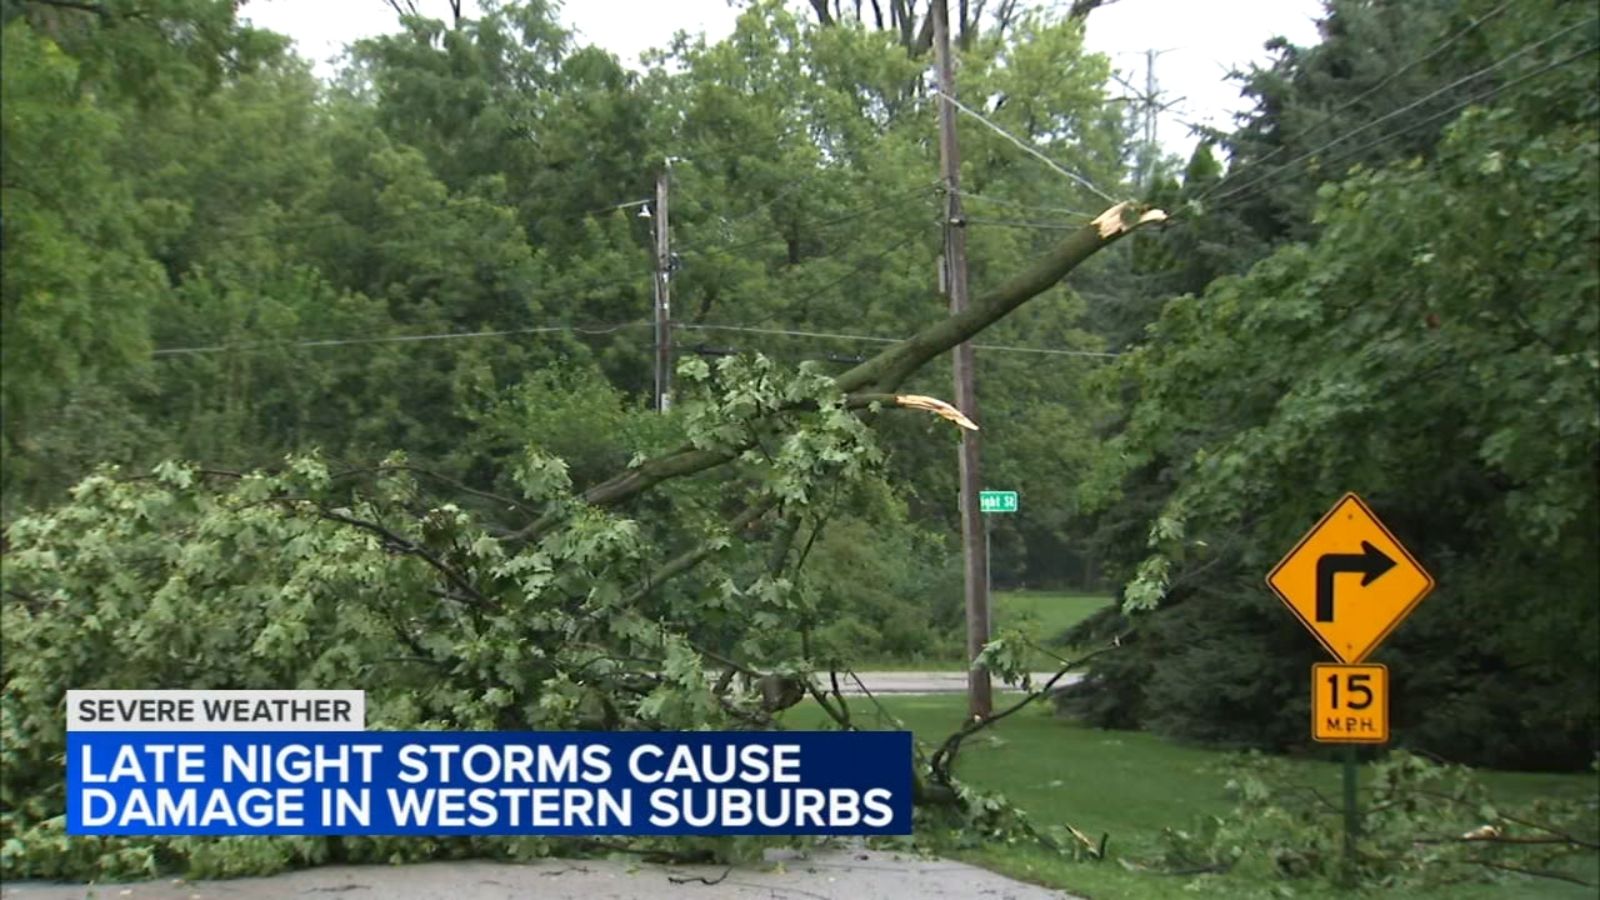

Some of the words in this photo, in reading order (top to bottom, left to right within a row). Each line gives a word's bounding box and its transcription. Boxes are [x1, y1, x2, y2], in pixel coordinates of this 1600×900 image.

[980, 495, 1001, 510] ight
[1003, 495, 1014, 508] St
[1328, 673, 1373, 710] 15
